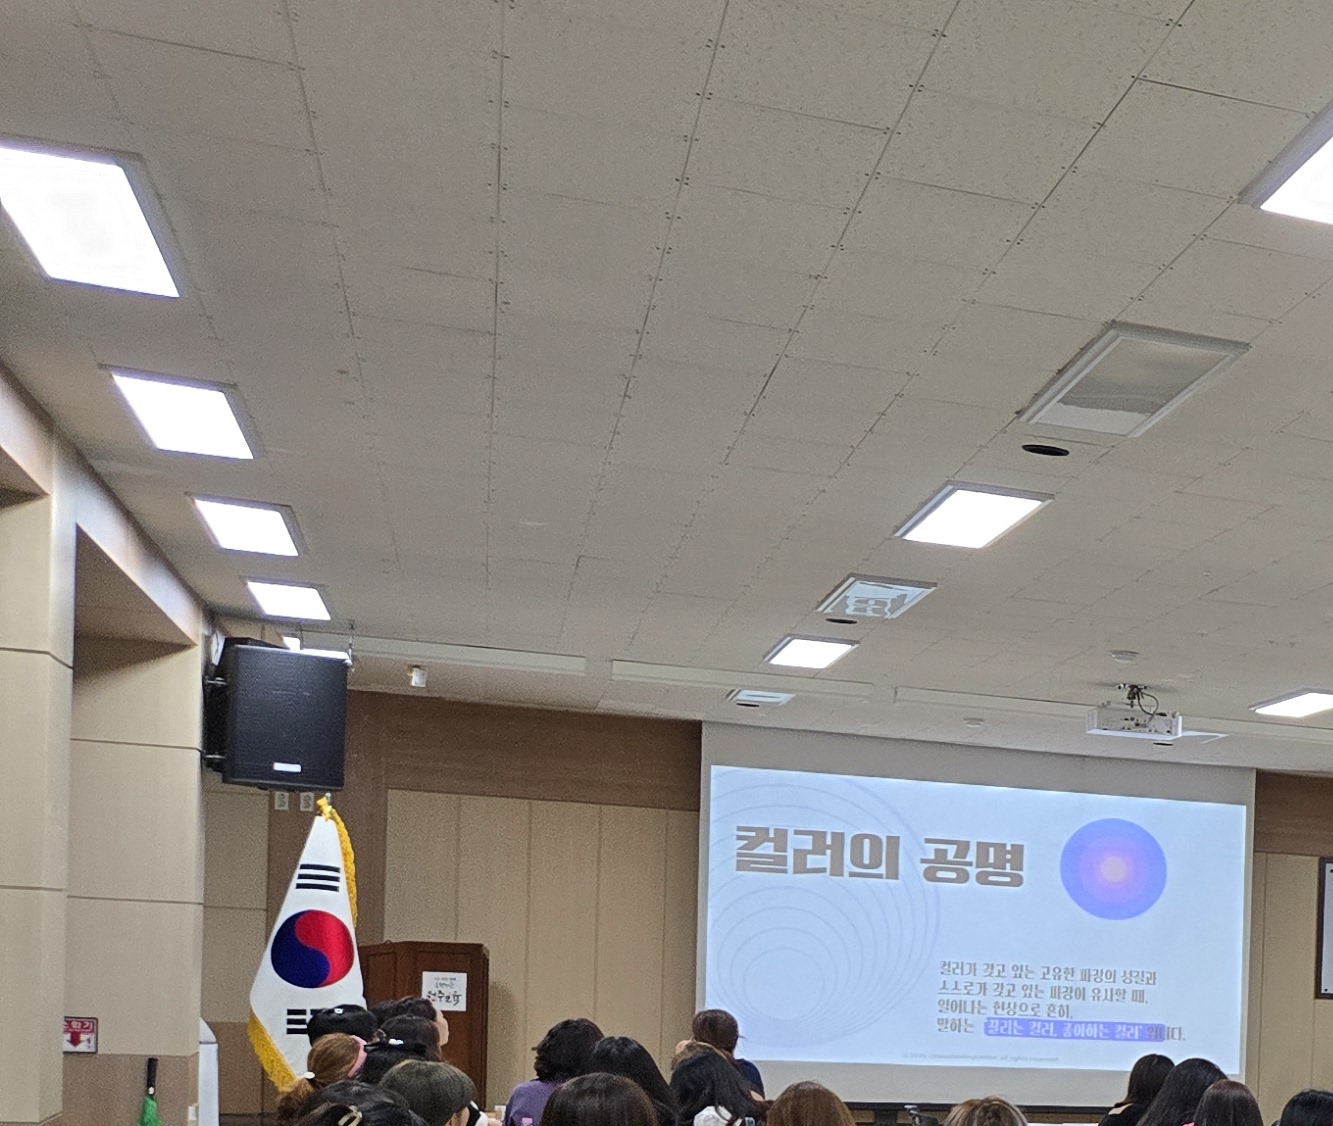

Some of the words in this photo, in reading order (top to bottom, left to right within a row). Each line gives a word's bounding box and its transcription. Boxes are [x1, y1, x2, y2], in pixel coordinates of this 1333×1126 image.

[736, 825, 900, 880] 컬러의
[919, 837, 1024, 887] 공명
[940, 960, 977, 976] 컬러가
[983, 963, 1007, 978] 갖고
[1011, 964, 1035, 979] 있는
[1040, 966, 1075, 981] 고유한
[1121, 970, 1157, 985] 성질과
[938, 980, 987, 996] 스스로가
[993, 983, 1016, 997] 갖고
[1021, 984, 1044, 999] 있는
[1091, 987, 1127, 1003] 유사할
[938, 999, 988, 1015] 일어나는
[993, 1001, 1042, 1017] 현상으로
[937, 1017, 976, 1033] 말하는
[1062, 1022, 1111, 1039] 좋아하는
